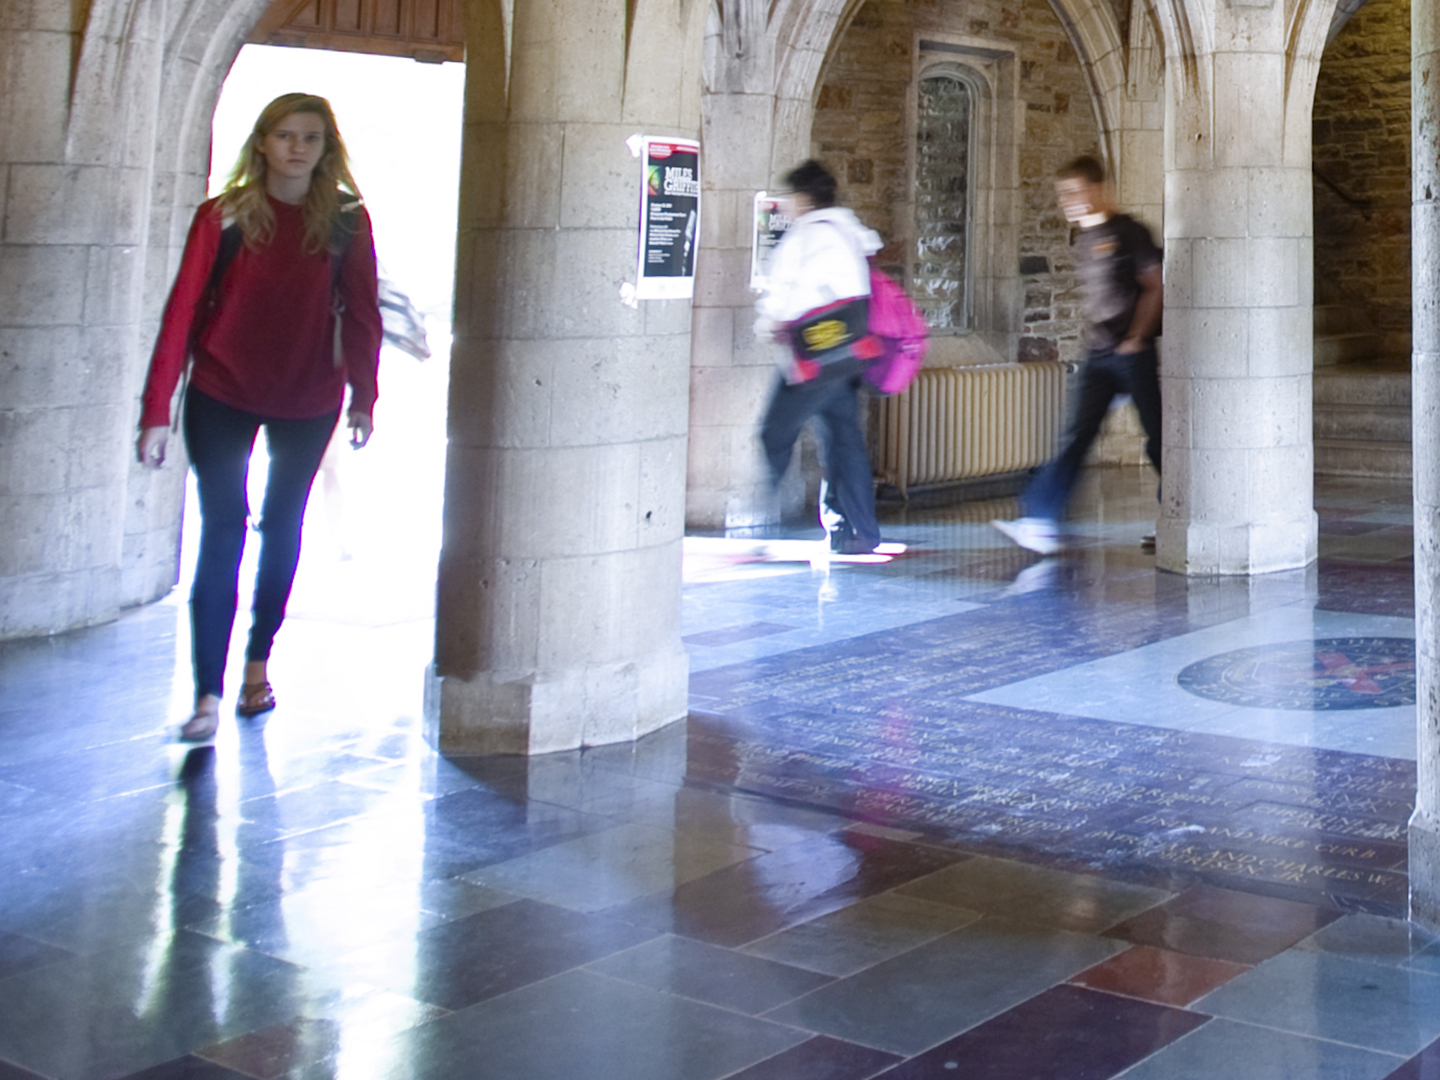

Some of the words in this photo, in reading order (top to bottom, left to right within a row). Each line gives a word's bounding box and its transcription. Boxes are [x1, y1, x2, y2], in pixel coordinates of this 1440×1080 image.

[1256, 833, 1309, 849] MIKE
[1314, 842, 1378, 860] CURB
[1205, 849, 1258, 866] AND
[1258, 857, 1361, 881] CHARLES
